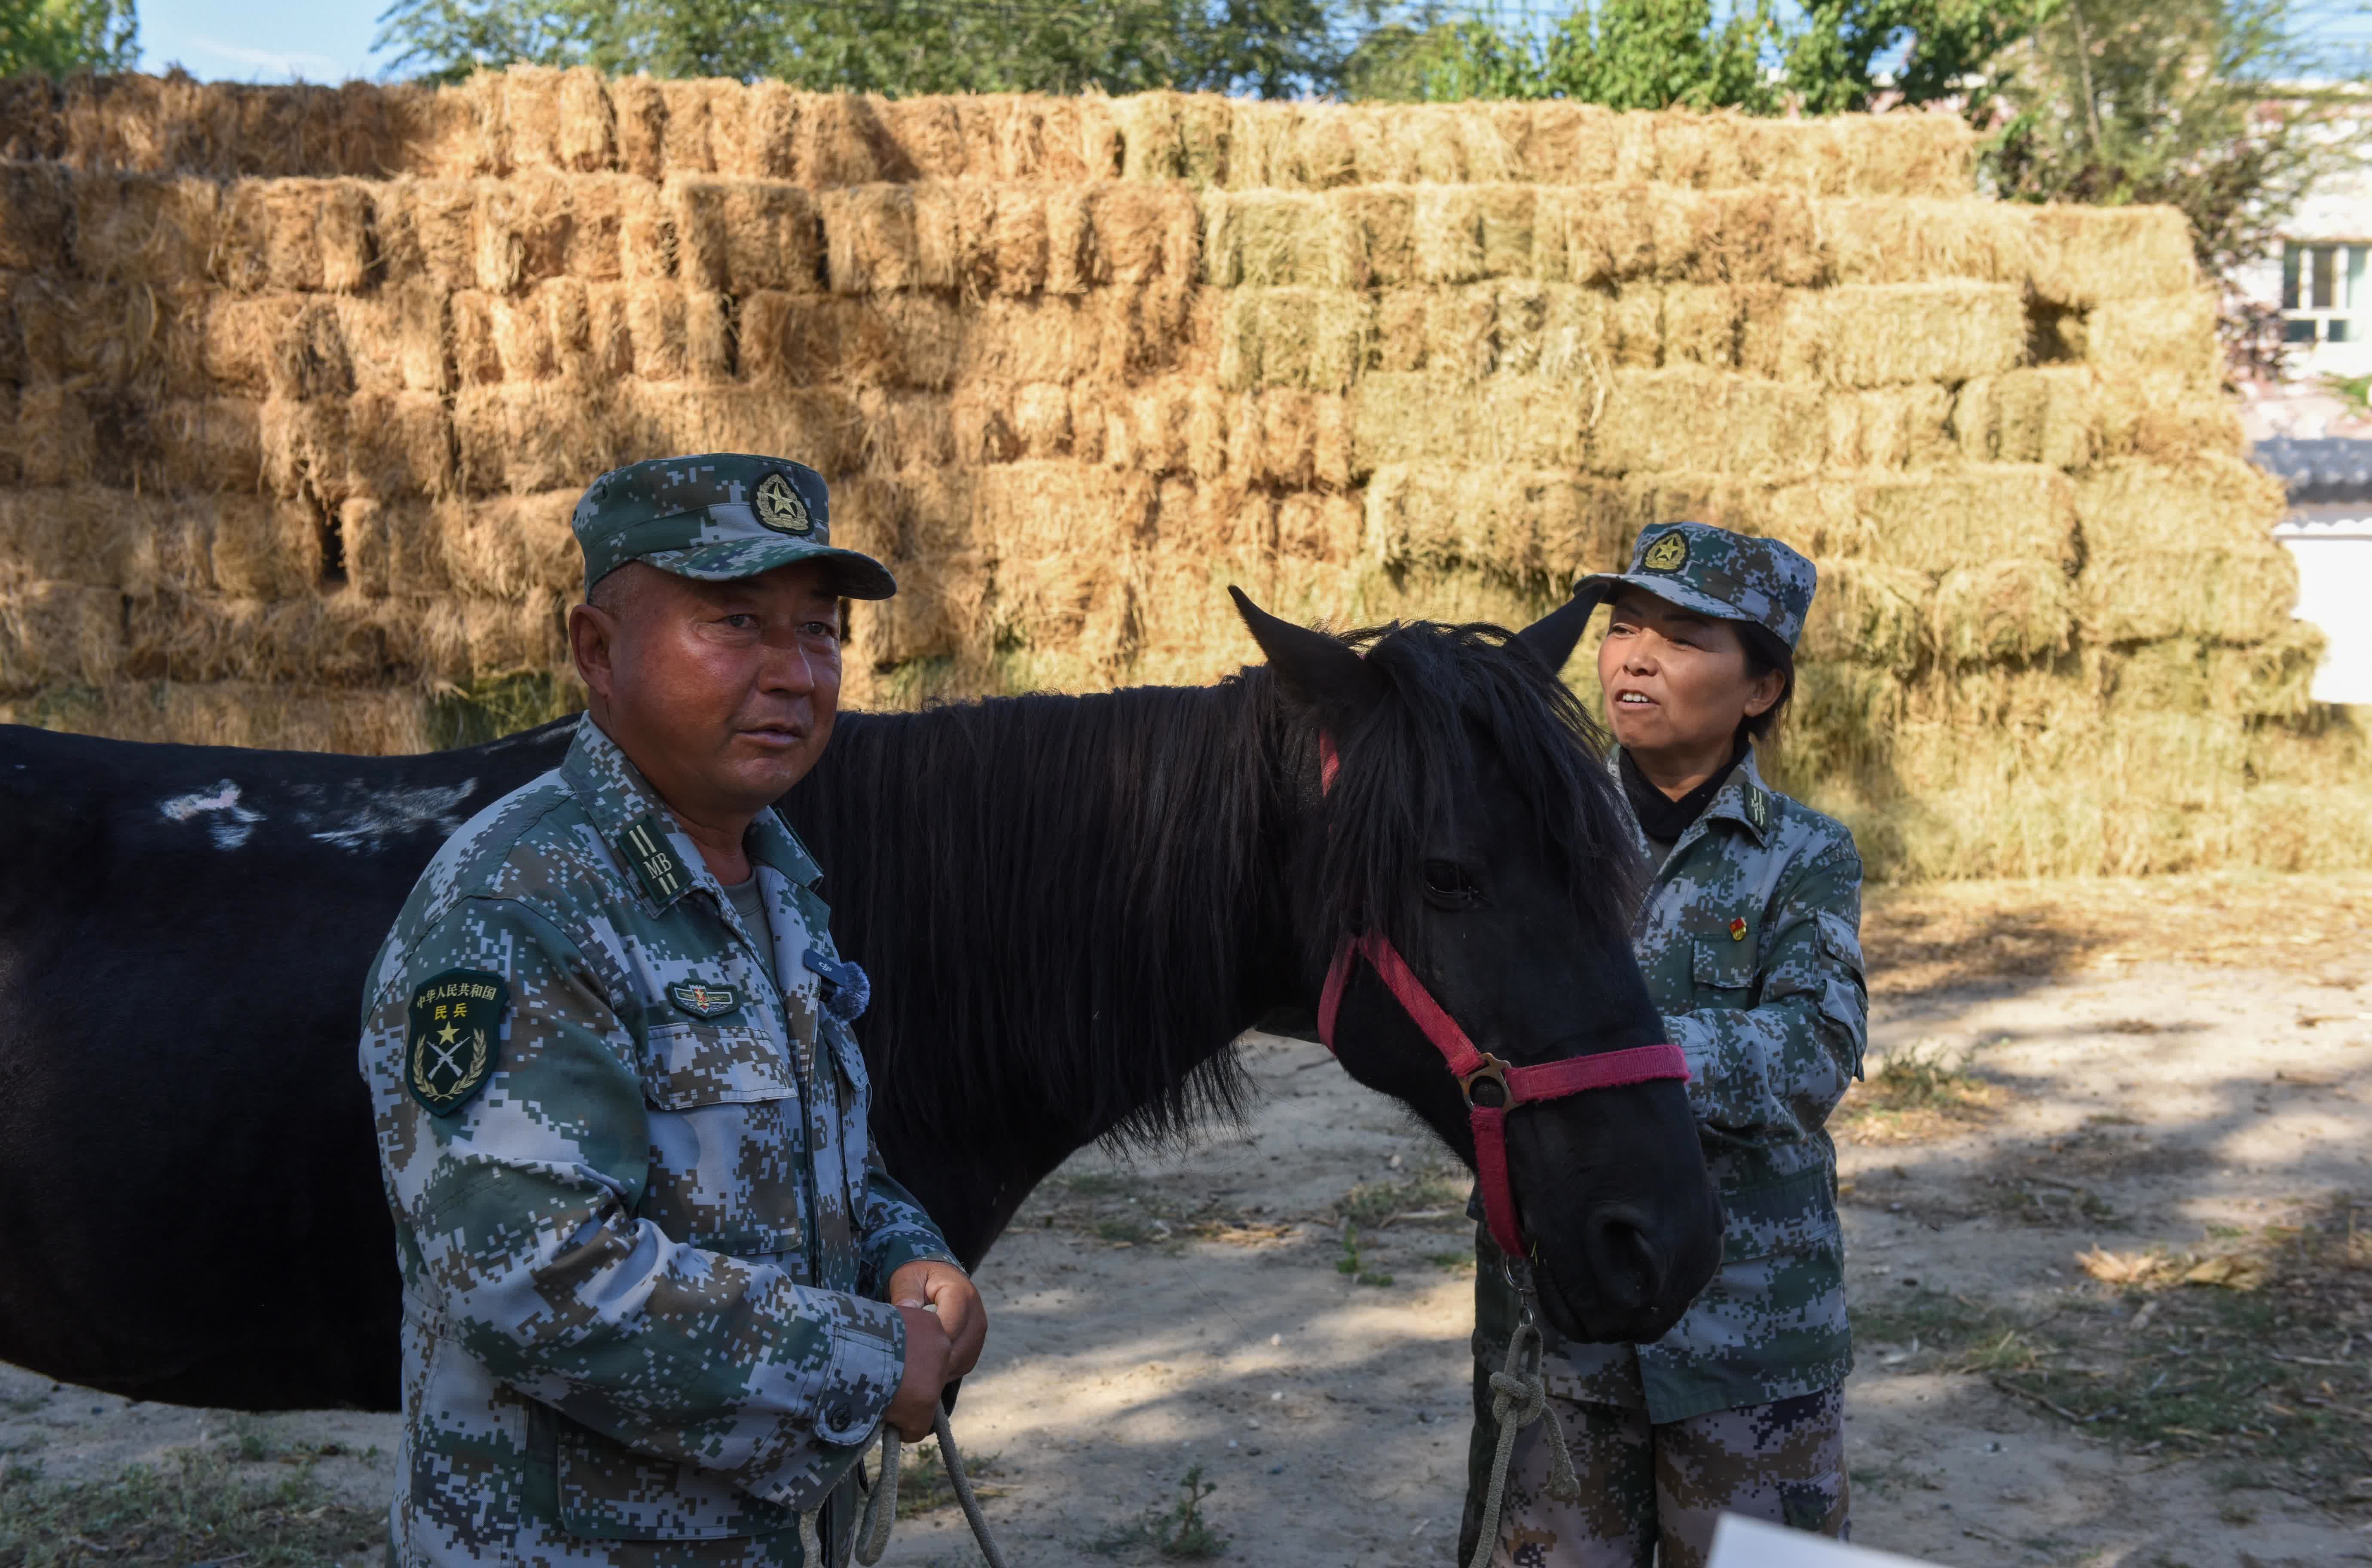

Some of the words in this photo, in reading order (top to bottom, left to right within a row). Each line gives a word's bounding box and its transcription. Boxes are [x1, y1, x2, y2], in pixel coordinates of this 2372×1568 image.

[643, 852, 672, 879] MB
[417, 983, 496, 1008] 中华人民共和国
[434, 1003, 468, 1020] 民兵
